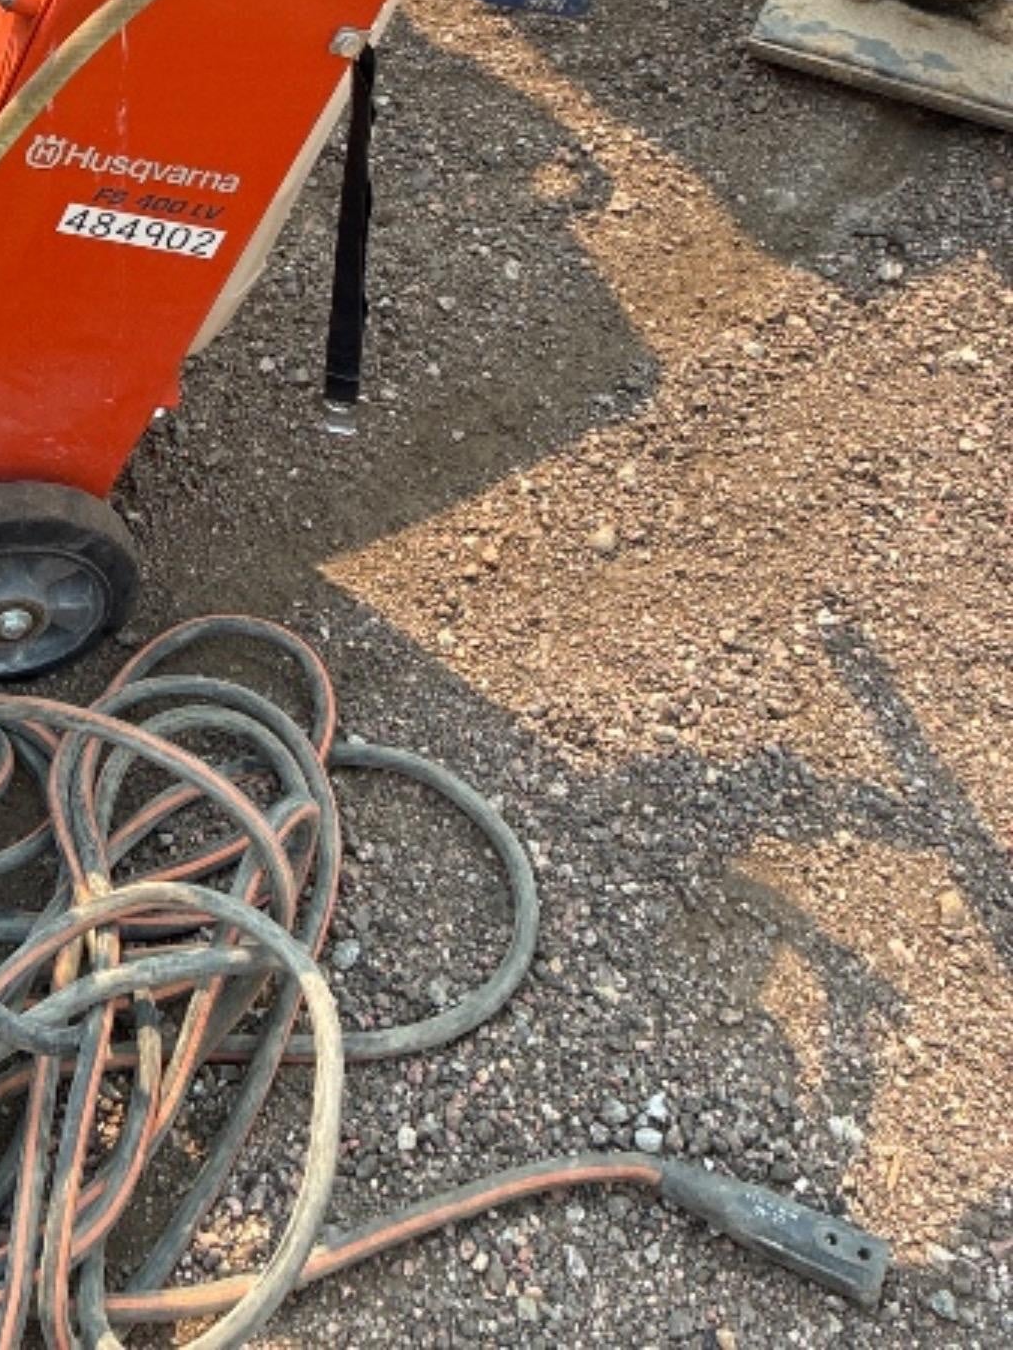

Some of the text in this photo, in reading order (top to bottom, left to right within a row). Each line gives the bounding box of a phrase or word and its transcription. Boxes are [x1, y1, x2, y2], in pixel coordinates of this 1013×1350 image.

[64, 143, 241, 193] Husqvarna
[136, 193, 187, 214] 400
[65, 208, 216, 256] 484902
